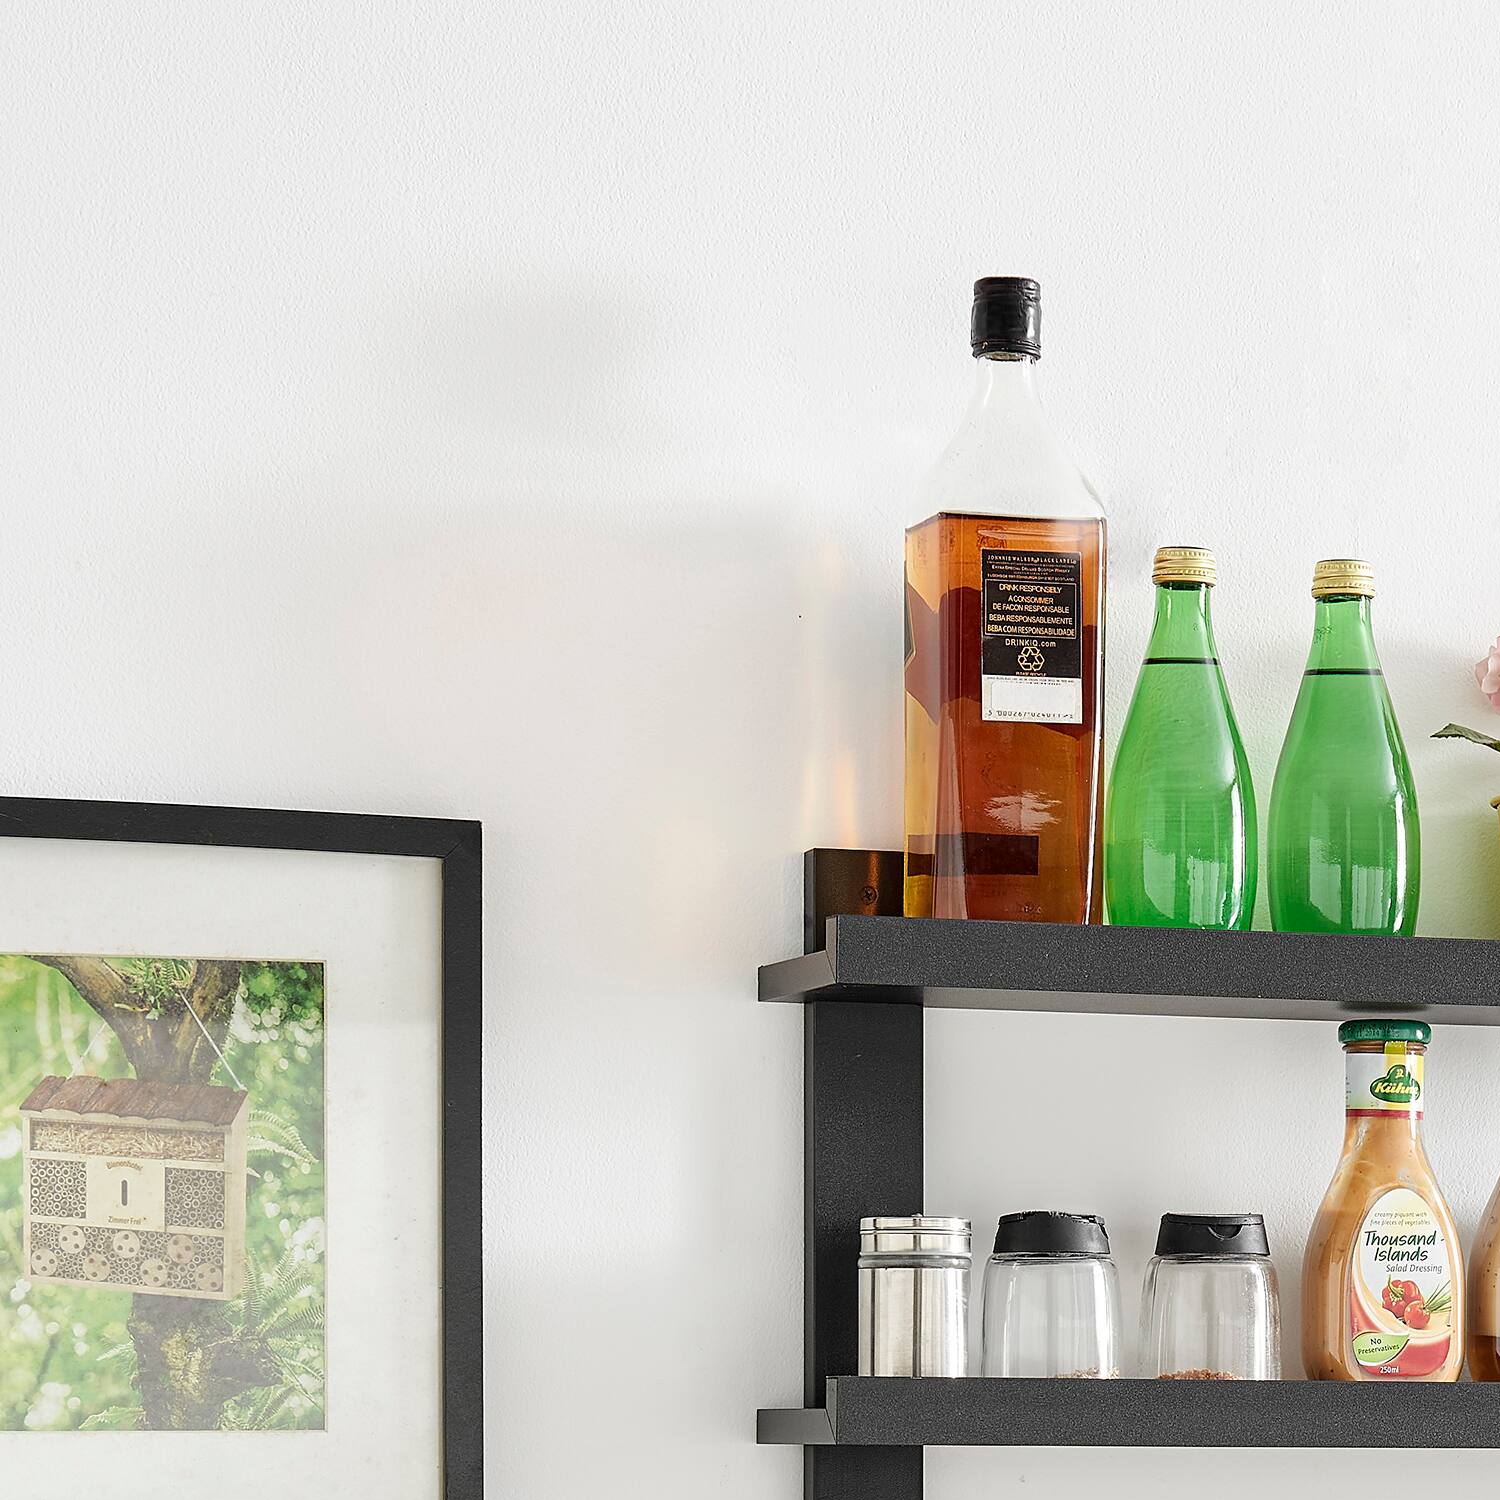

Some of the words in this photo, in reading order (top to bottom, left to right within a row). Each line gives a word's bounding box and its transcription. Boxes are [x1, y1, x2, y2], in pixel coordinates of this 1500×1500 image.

[1024, 605, 1069, 613] RESPONSABLE
[1006, 615, 1073, 625] RESPONSABLEMENTE
[987, 624, 1002, 632] BEBA
[1018, 626, 1075, 636] RESPONSABILIDADE
[1364, 1230, 1437, 1246] Thousand
[1374, 1246, 1428, 1262] Islands
[1386, 1264, 1408, 1273] Salad
[1410, 1264, 1443, 1274] Dressing
[1357, 1344, 1400, 1354] Preservatives
